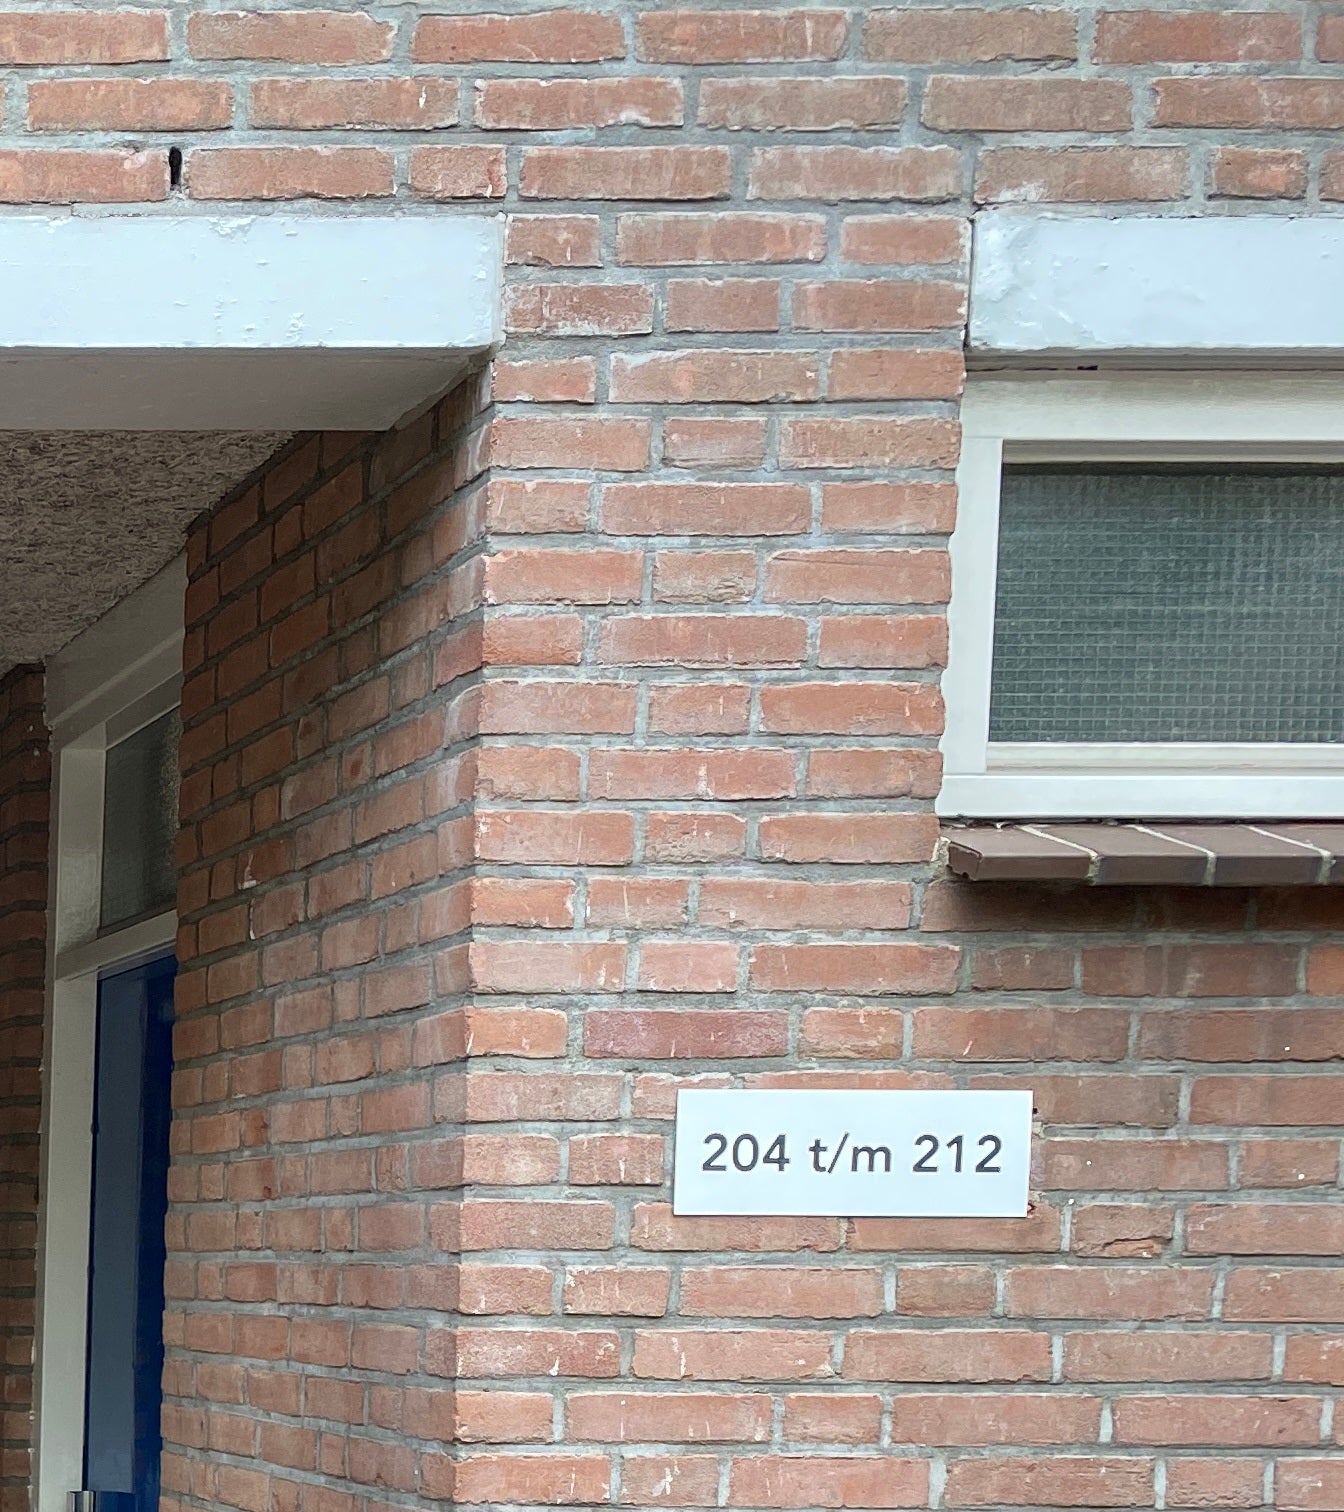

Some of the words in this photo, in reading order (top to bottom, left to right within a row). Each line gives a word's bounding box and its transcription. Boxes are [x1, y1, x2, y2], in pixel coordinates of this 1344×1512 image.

[701, 1132, 790, 1173] 204
[807, 1131, 892, 1175] t/m
[911, 1133, 1003, 1174] 212
